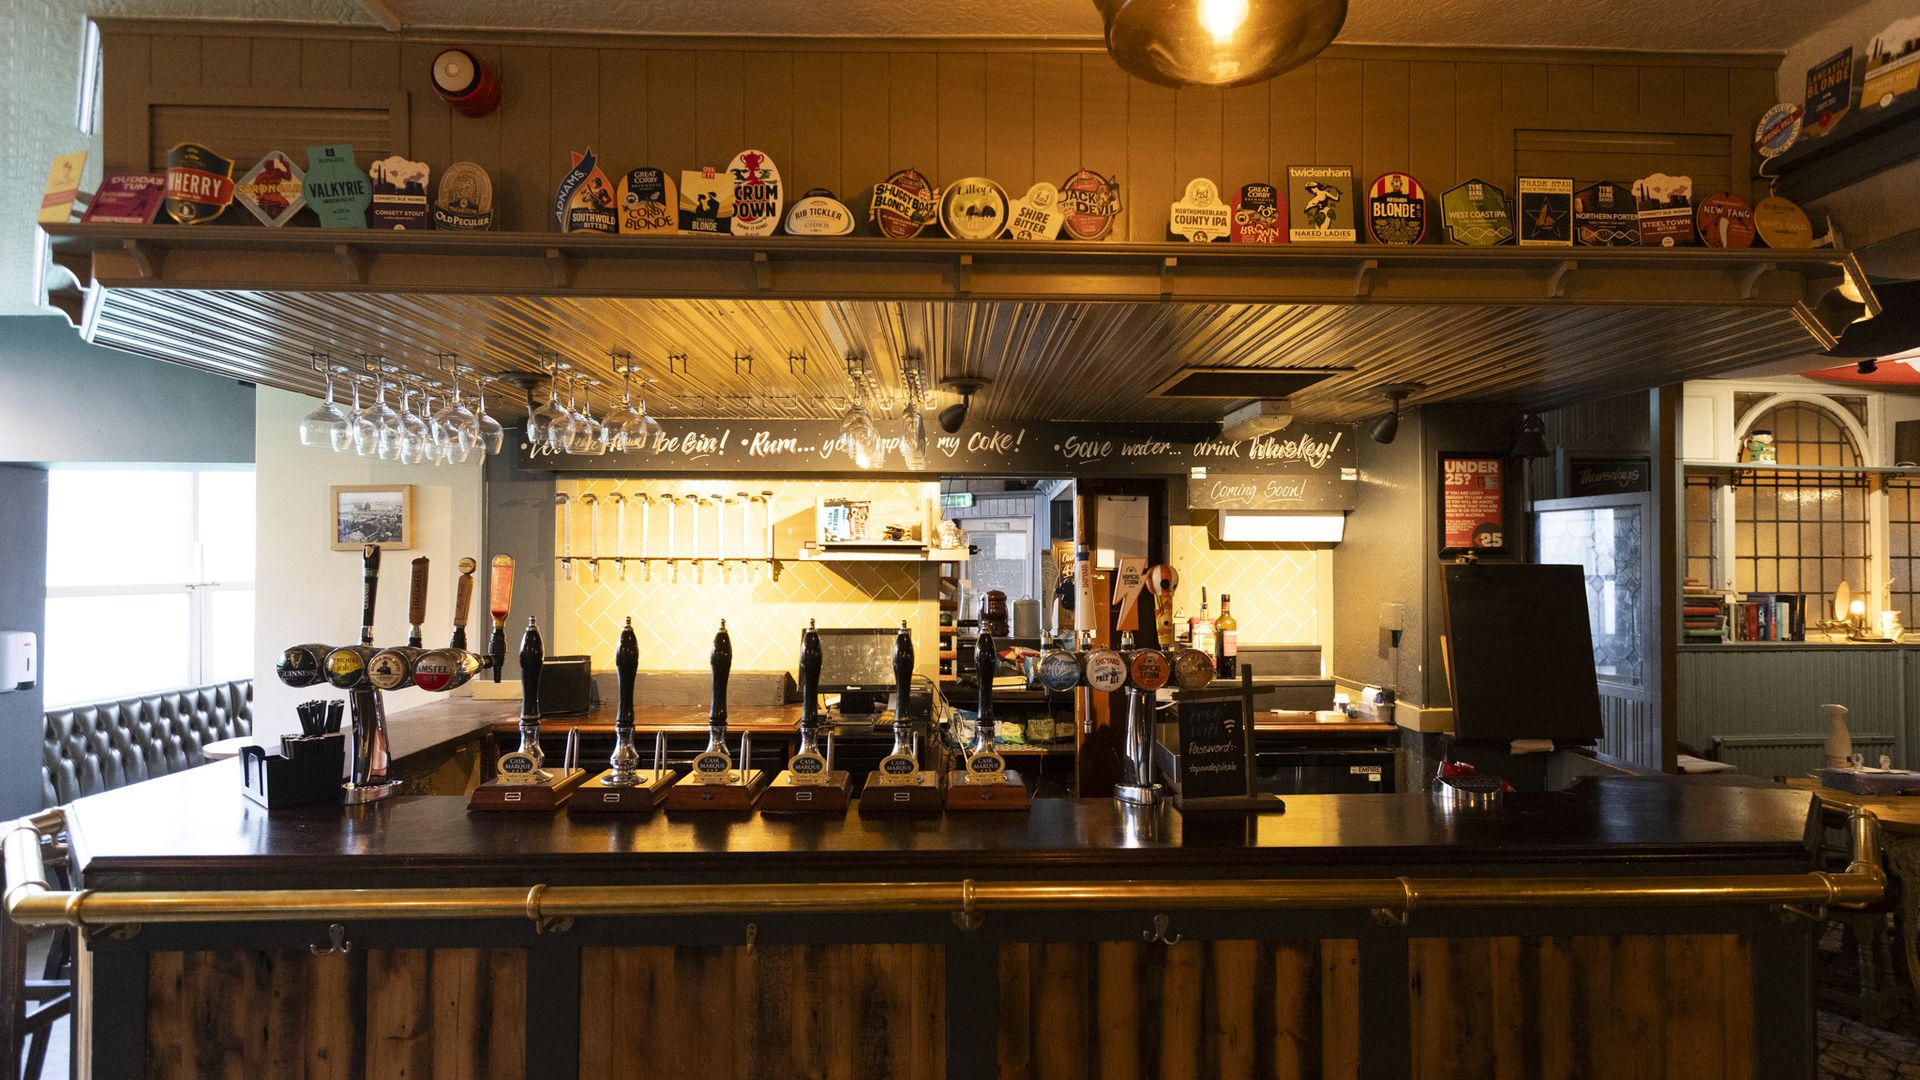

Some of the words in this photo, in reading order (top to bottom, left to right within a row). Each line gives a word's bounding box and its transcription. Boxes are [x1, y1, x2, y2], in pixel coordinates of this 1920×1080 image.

[1807, 67, 1850, 98] BLONDE
[1291, 168, 1352, 178] twickenham
[308, 181, 364, 198] VALKYRIE
[1057, 189, 1097, 204] JACK
[629, 206, 667, 220] CORBY
[874, 196, 912, 217] BLONDE
[1075, 201, 1118, 217] DEVIL
[1175, 208, 1228, 216] NORTHUMBERLAND
[1373, 202, 1416, 218] BLONDE
[1704, 206, 1723, 215] NEW
[1728, 209, 1750, 218] FANG
[436, 211, 454, 223] OLD
[454, 216, 490, 226] PECULIER
[572, 213, 617, 225] SOUTHWOLD
[795, 209, 808, 220] RIB
[810, 208, 843, 221] TICKLER
[1018, 207, 1050, 224] SHIRE
[1175, 215, 1210, 226] COUNTY
[1212, 216, 1227, 227] IPA
[692, 220, 718, 231] BLONDE
[1013, 217, 1046, 234] BITTER
[1641, 219, 1691, 228] STEELTOWN
[1295, 230, 1322, 238] NAKED
[1324, 230, 1351, 238] LADIES
[682, 429, 731, 457] Gin!
[936, 437, 960, 458] my
[967, 428, 1026, 454] Coke!
[1063, 436, 1113, 458] Save
[1122, 438, 1182, 457] water...
[1193, 438, 1241, 459] drink
[1249, 432, 1342, 469] Whiskey!
[1444, 461, 1499, 473] UNDER
[1444, 473, 1472, 485] 25?
[1579, 467, 1640, 489] Thursdays
[1211, 481, 1257, 505] Coming
[1264, 480, 1308, 499] Soon!
[1481, 532, 1503, 547] 25
[416, 665, 449, 673] AMSTEL
